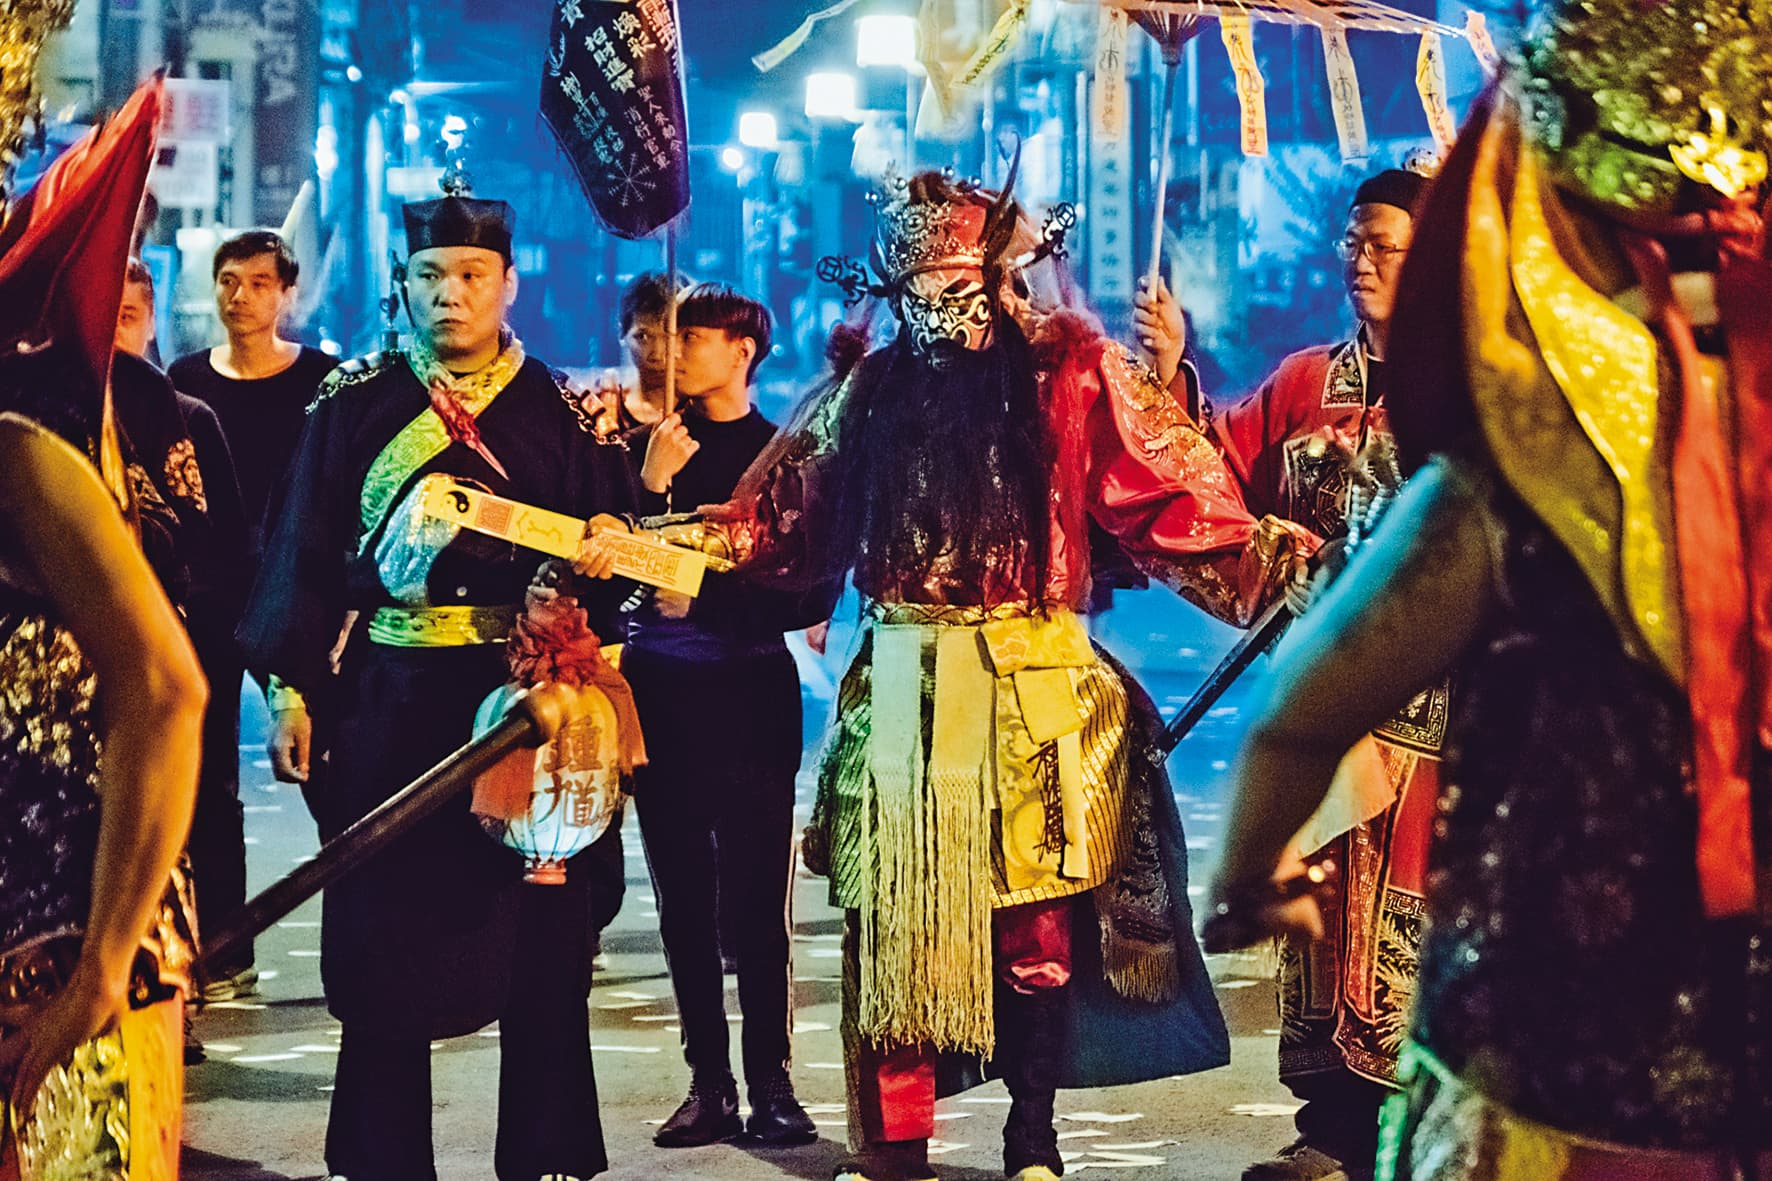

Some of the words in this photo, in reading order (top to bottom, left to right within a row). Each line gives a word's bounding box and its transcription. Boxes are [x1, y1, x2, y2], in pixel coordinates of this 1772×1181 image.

[584, 26, 636, 94] 招財進寶
[612, 10, 657, 59] 煥彩
[535, 712, 604, 828] 鍾馗
